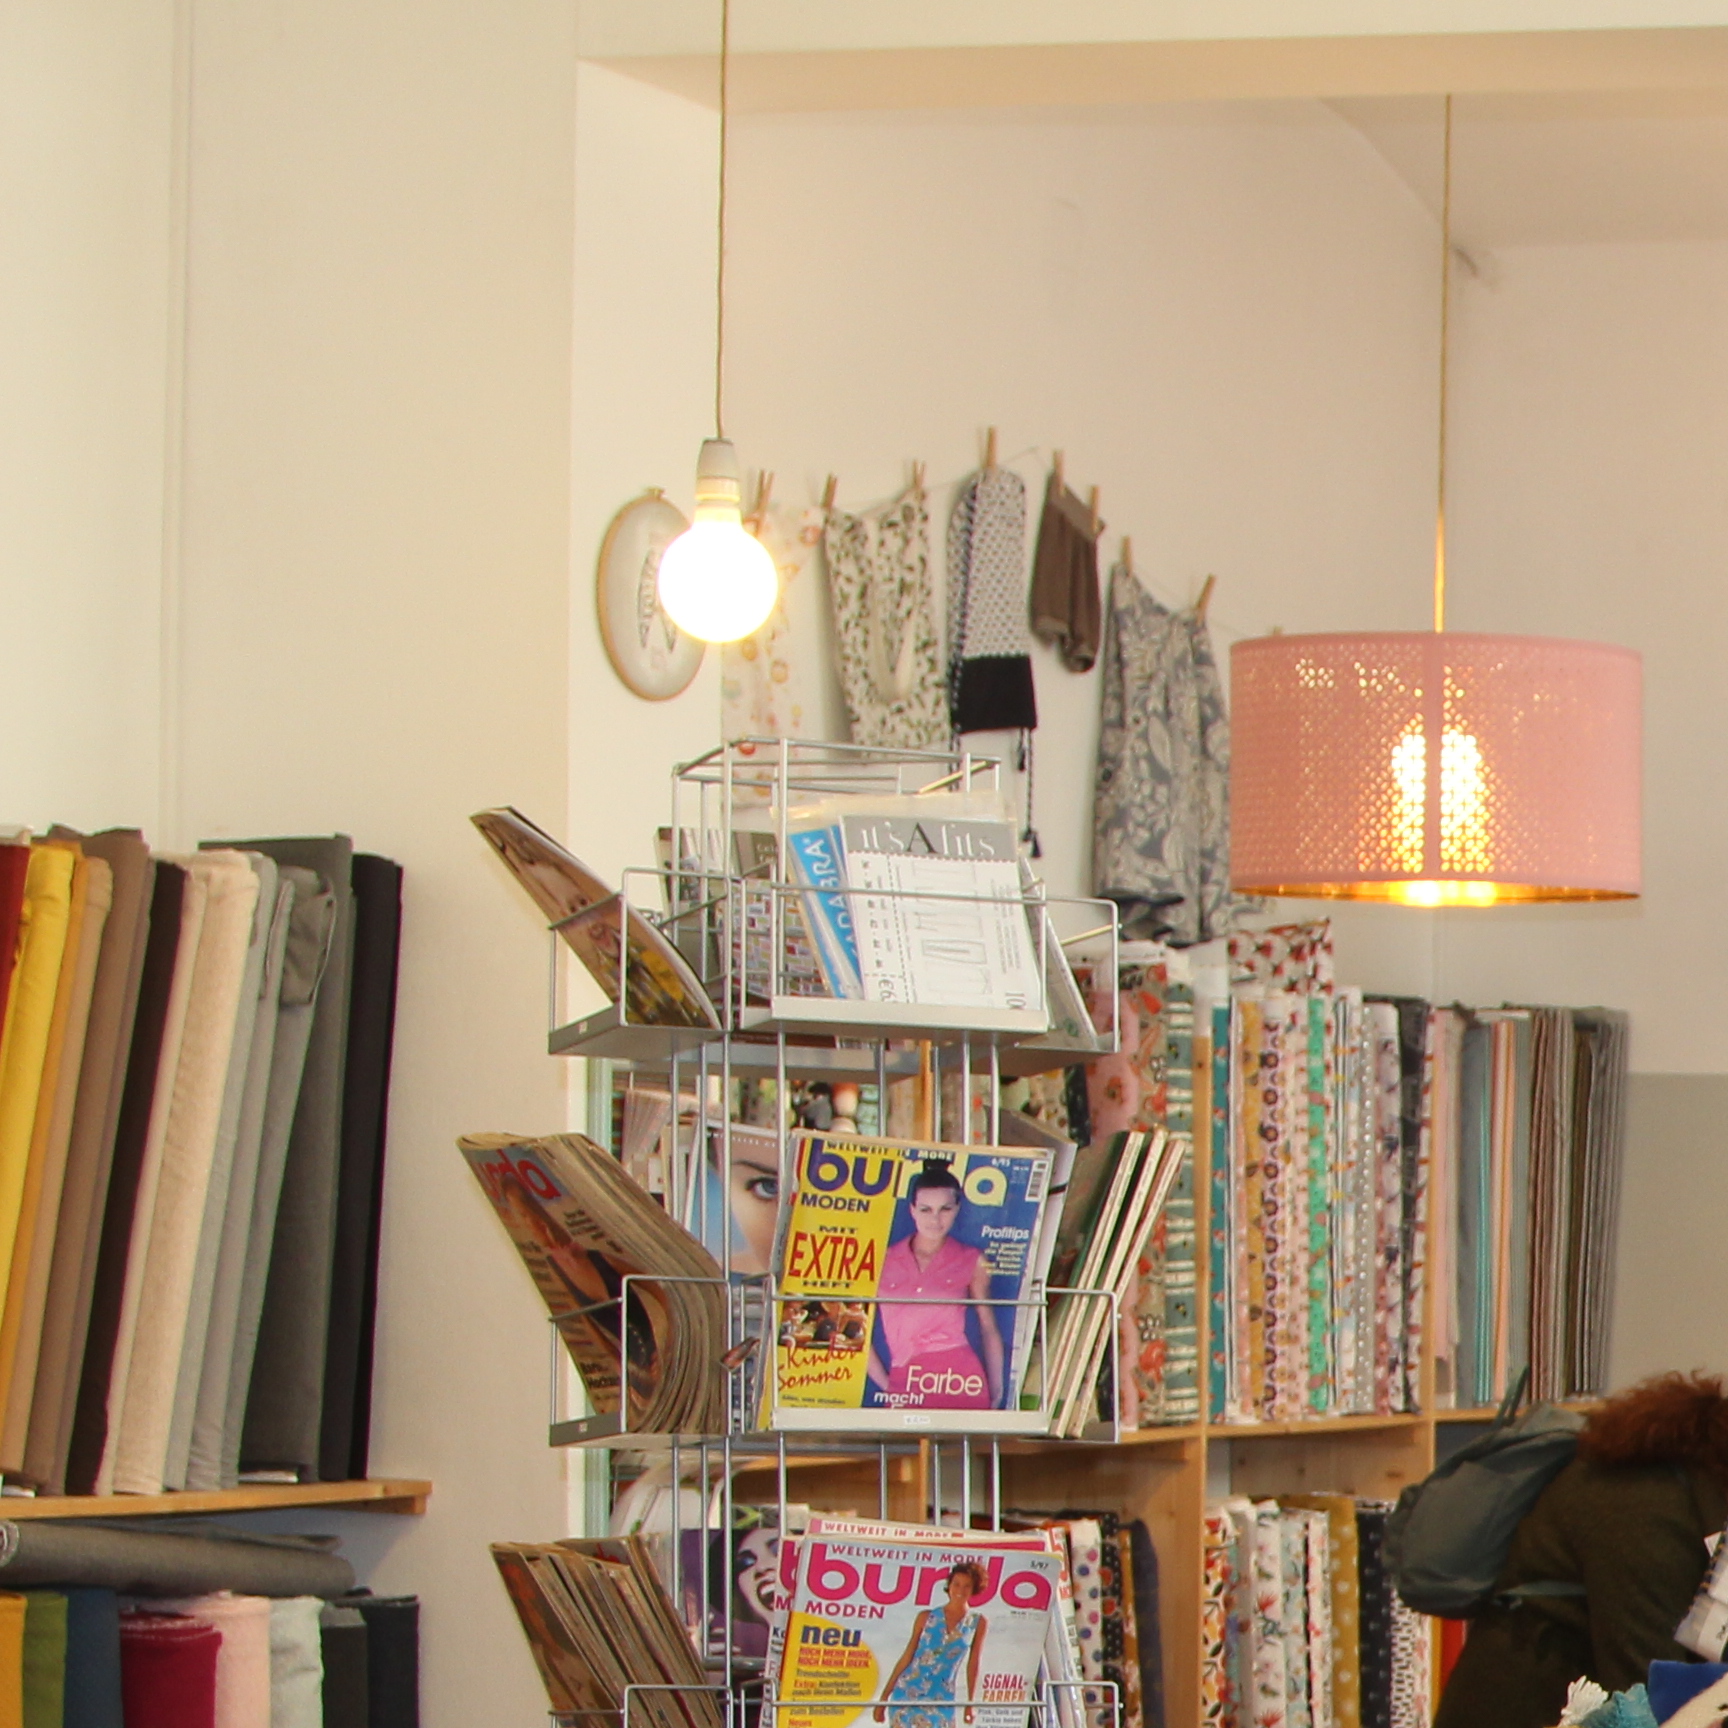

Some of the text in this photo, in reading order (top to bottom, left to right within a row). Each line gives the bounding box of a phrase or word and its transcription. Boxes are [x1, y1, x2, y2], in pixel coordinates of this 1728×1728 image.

[800, 1193, 871, 1213] MODEN
[981, 1225, 1030, 1241] Profitips
[787, 1231, 876, 1283] EXTRA
[786, 1332, 858, 1370] Kinder
[777, 1365, 853, 1392] Sommer
[906, 1365, 984, 1397] Farbe
[873, 1391, 925, 1406] macht
[831, 1544, 909, 1562] WELTWEIT
[915, 1551, 933, 1563] IN
[805, 1600, 885, 1620] MODEN
[801, 1625, 864, 1648] neu
[982, 1673, 1029, 1690] SIGNAL-
